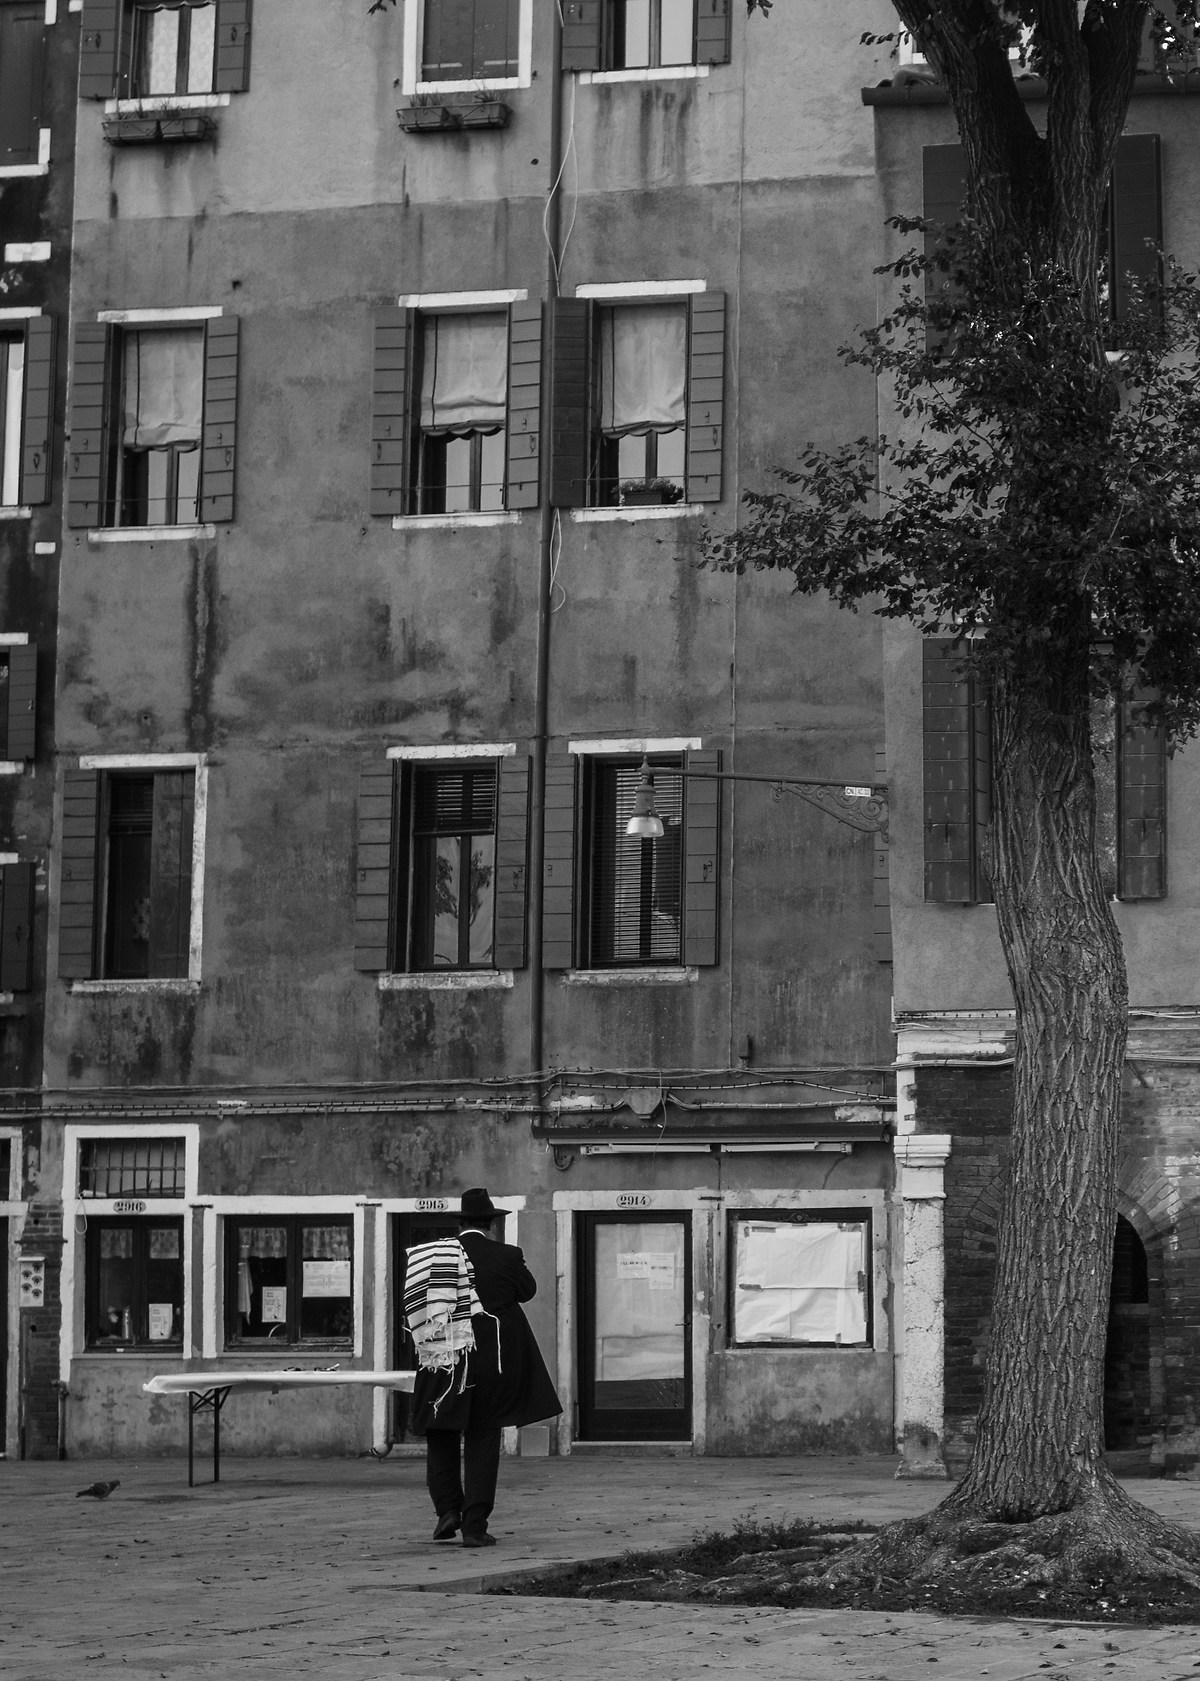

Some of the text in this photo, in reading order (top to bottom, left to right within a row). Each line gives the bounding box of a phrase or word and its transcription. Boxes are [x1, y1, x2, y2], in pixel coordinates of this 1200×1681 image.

[419, 1200, 444, 1209] 2915
[620, 1196, 646, 1205] 2914
[117, 1202, 142, 1211] 2916
